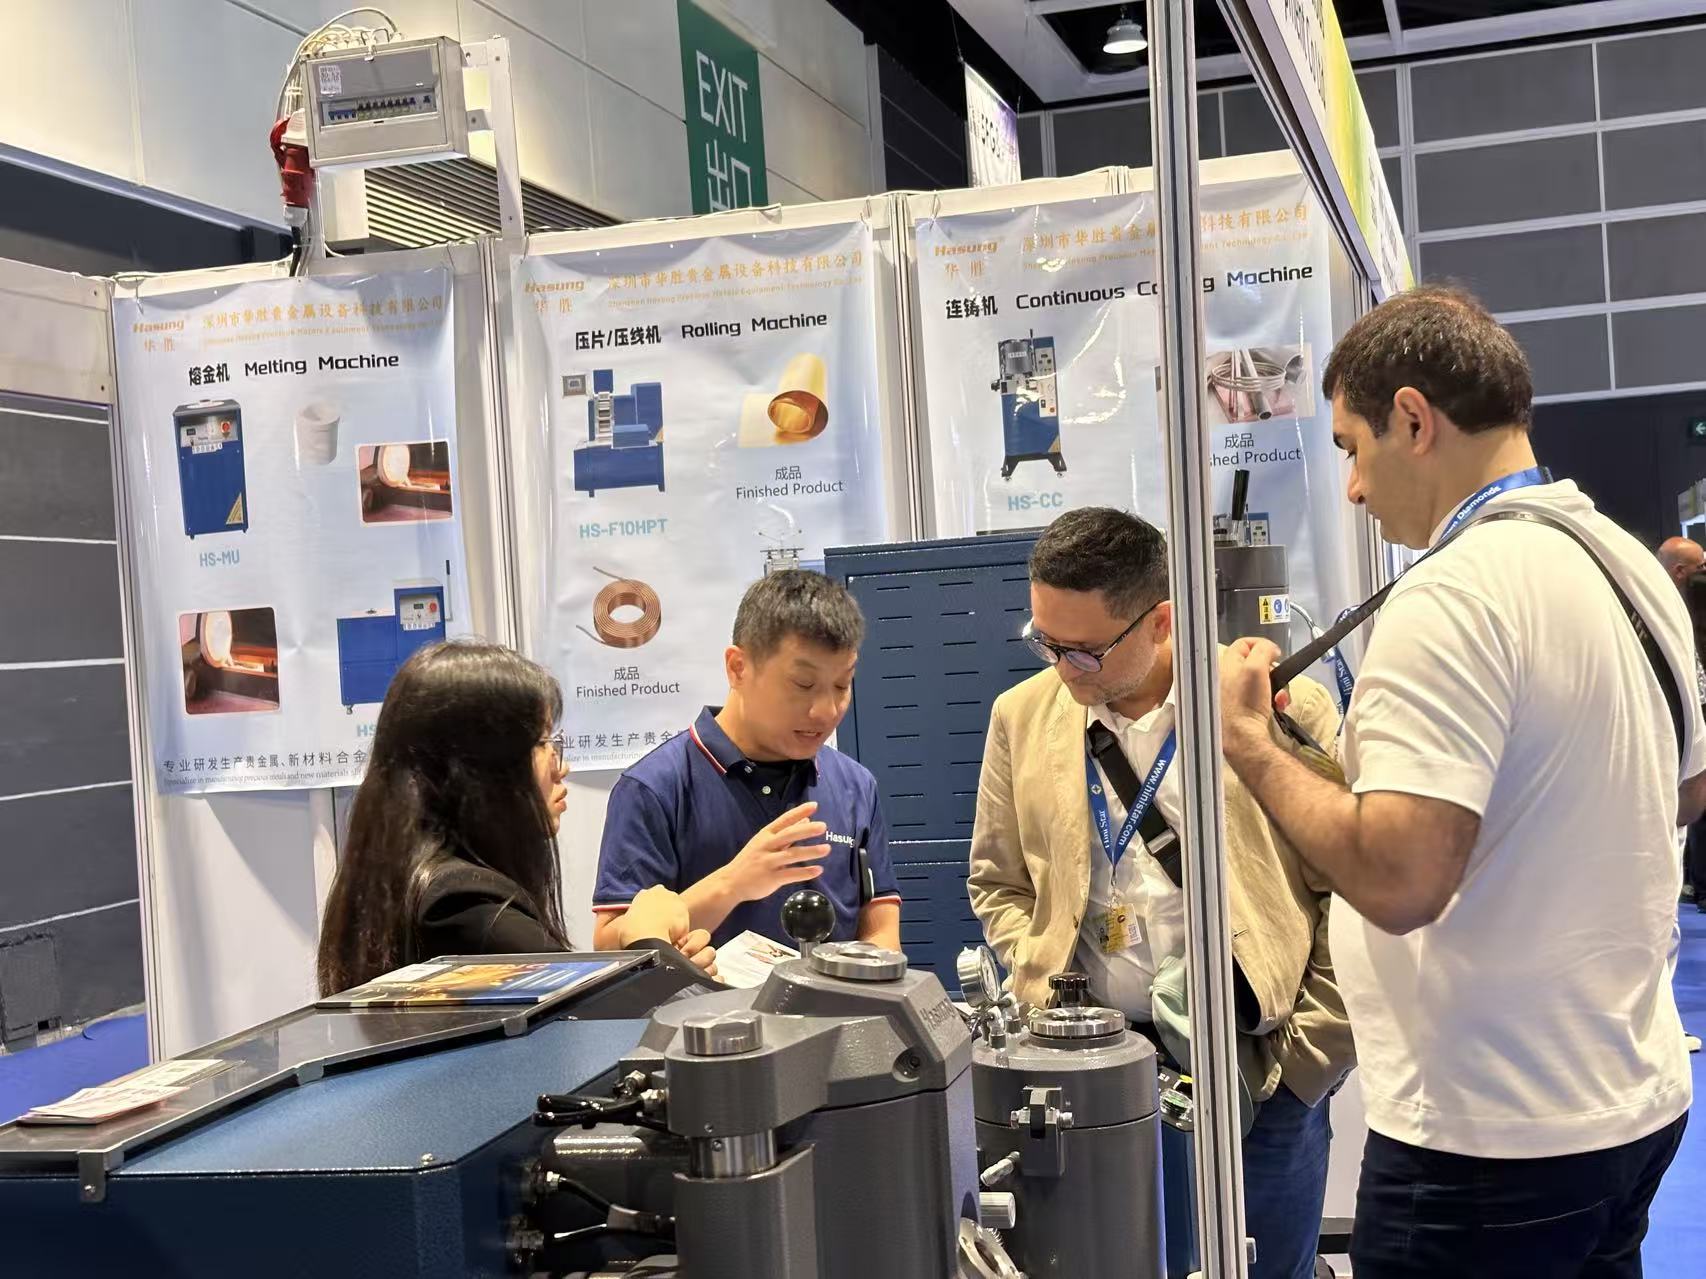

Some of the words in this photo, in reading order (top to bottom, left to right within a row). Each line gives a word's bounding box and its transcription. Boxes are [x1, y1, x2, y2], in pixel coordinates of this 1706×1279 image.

[696, 49, 748, 143] EXIT
[934, 241, 998, 256] Hasung
[525, 280, 584, 294] Hasung
[1016, 286, 1125, 310] Continuous
[1226, 266, 1313, 288] Machine
[945, 295, 999, 320] 连铸机
[681, 321, 741, 339] Rolling
[751, 313, 827, 333] Machine
[575, 325, 662, 351] 压片/压线机
[188, 362, 231, 387] 熔金机
[244, 359, 307, 377] Melting
[318, 354, 399, 371] Machine
[1225, 433, 1254, 449] 成品
[1245, 448, 1302, 464] Product
[775, 465, 802, 480] 成品
[736, 483, 788, 500] Finished
[793, 480, 844, 495] Product
[1007, 491, 1064, 511] HS-CC
[1457, 486, 1502, 520] Diamonds
[579, 518, 668, 539] HS-F10HPT
[199, 548, 240, 567] HS-MU
[614, 666, 640, 681] 成品
[576, 683, 627, 698] Finished
[631, 681, 680, 695] Product
[1118, 759, 1166, 846] www.hinistar.com
